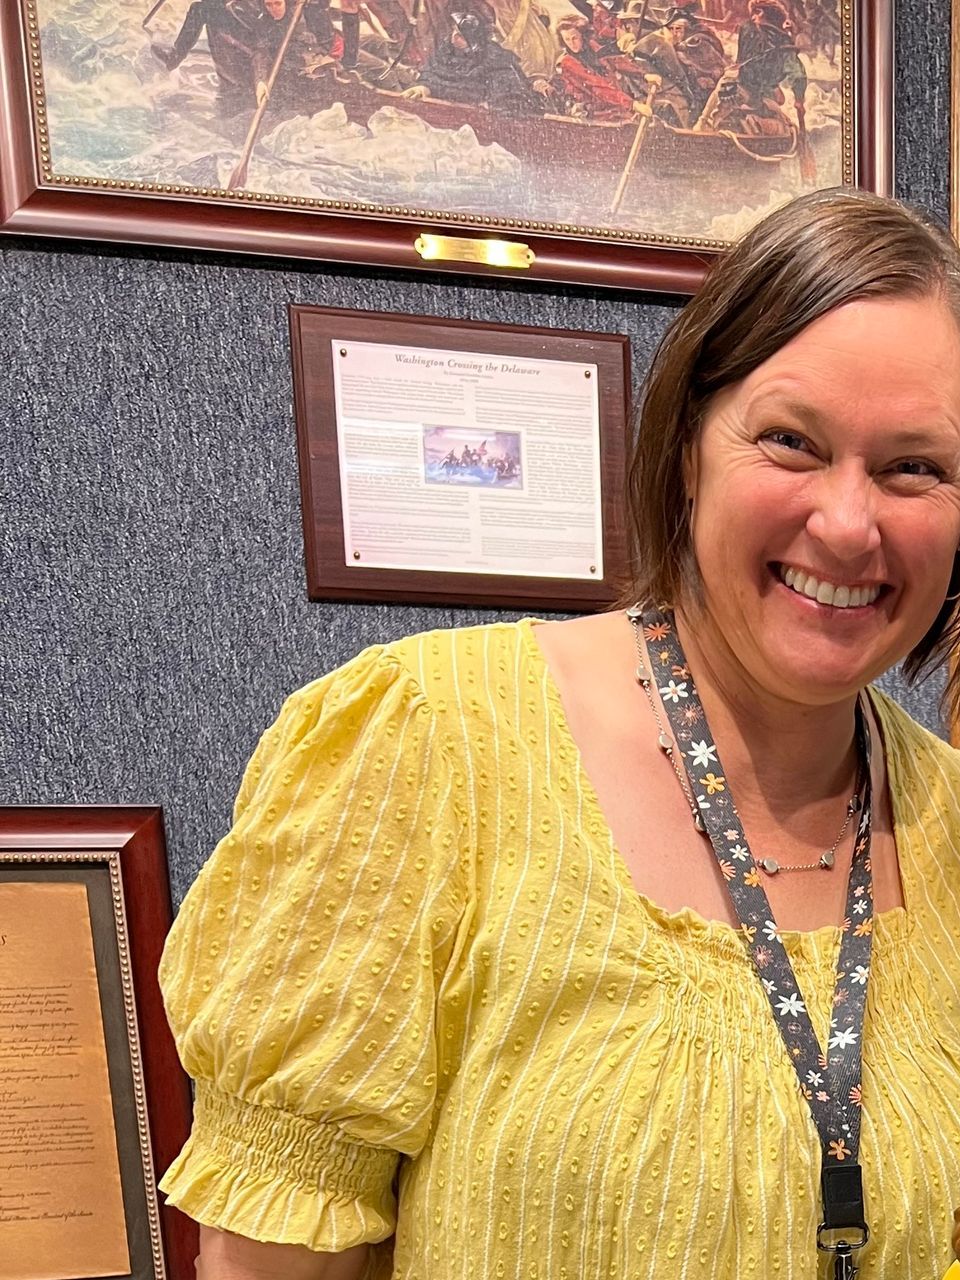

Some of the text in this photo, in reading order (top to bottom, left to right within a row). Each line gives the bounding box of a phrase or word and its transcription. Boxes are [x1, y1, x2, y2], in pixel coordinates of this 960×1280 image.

[394, 354, 445, 368] Washington
[447, 358, 483, 373] Crossing
[485, 362, 498, 372] the
[501, 364, 541, 376] Delaware
